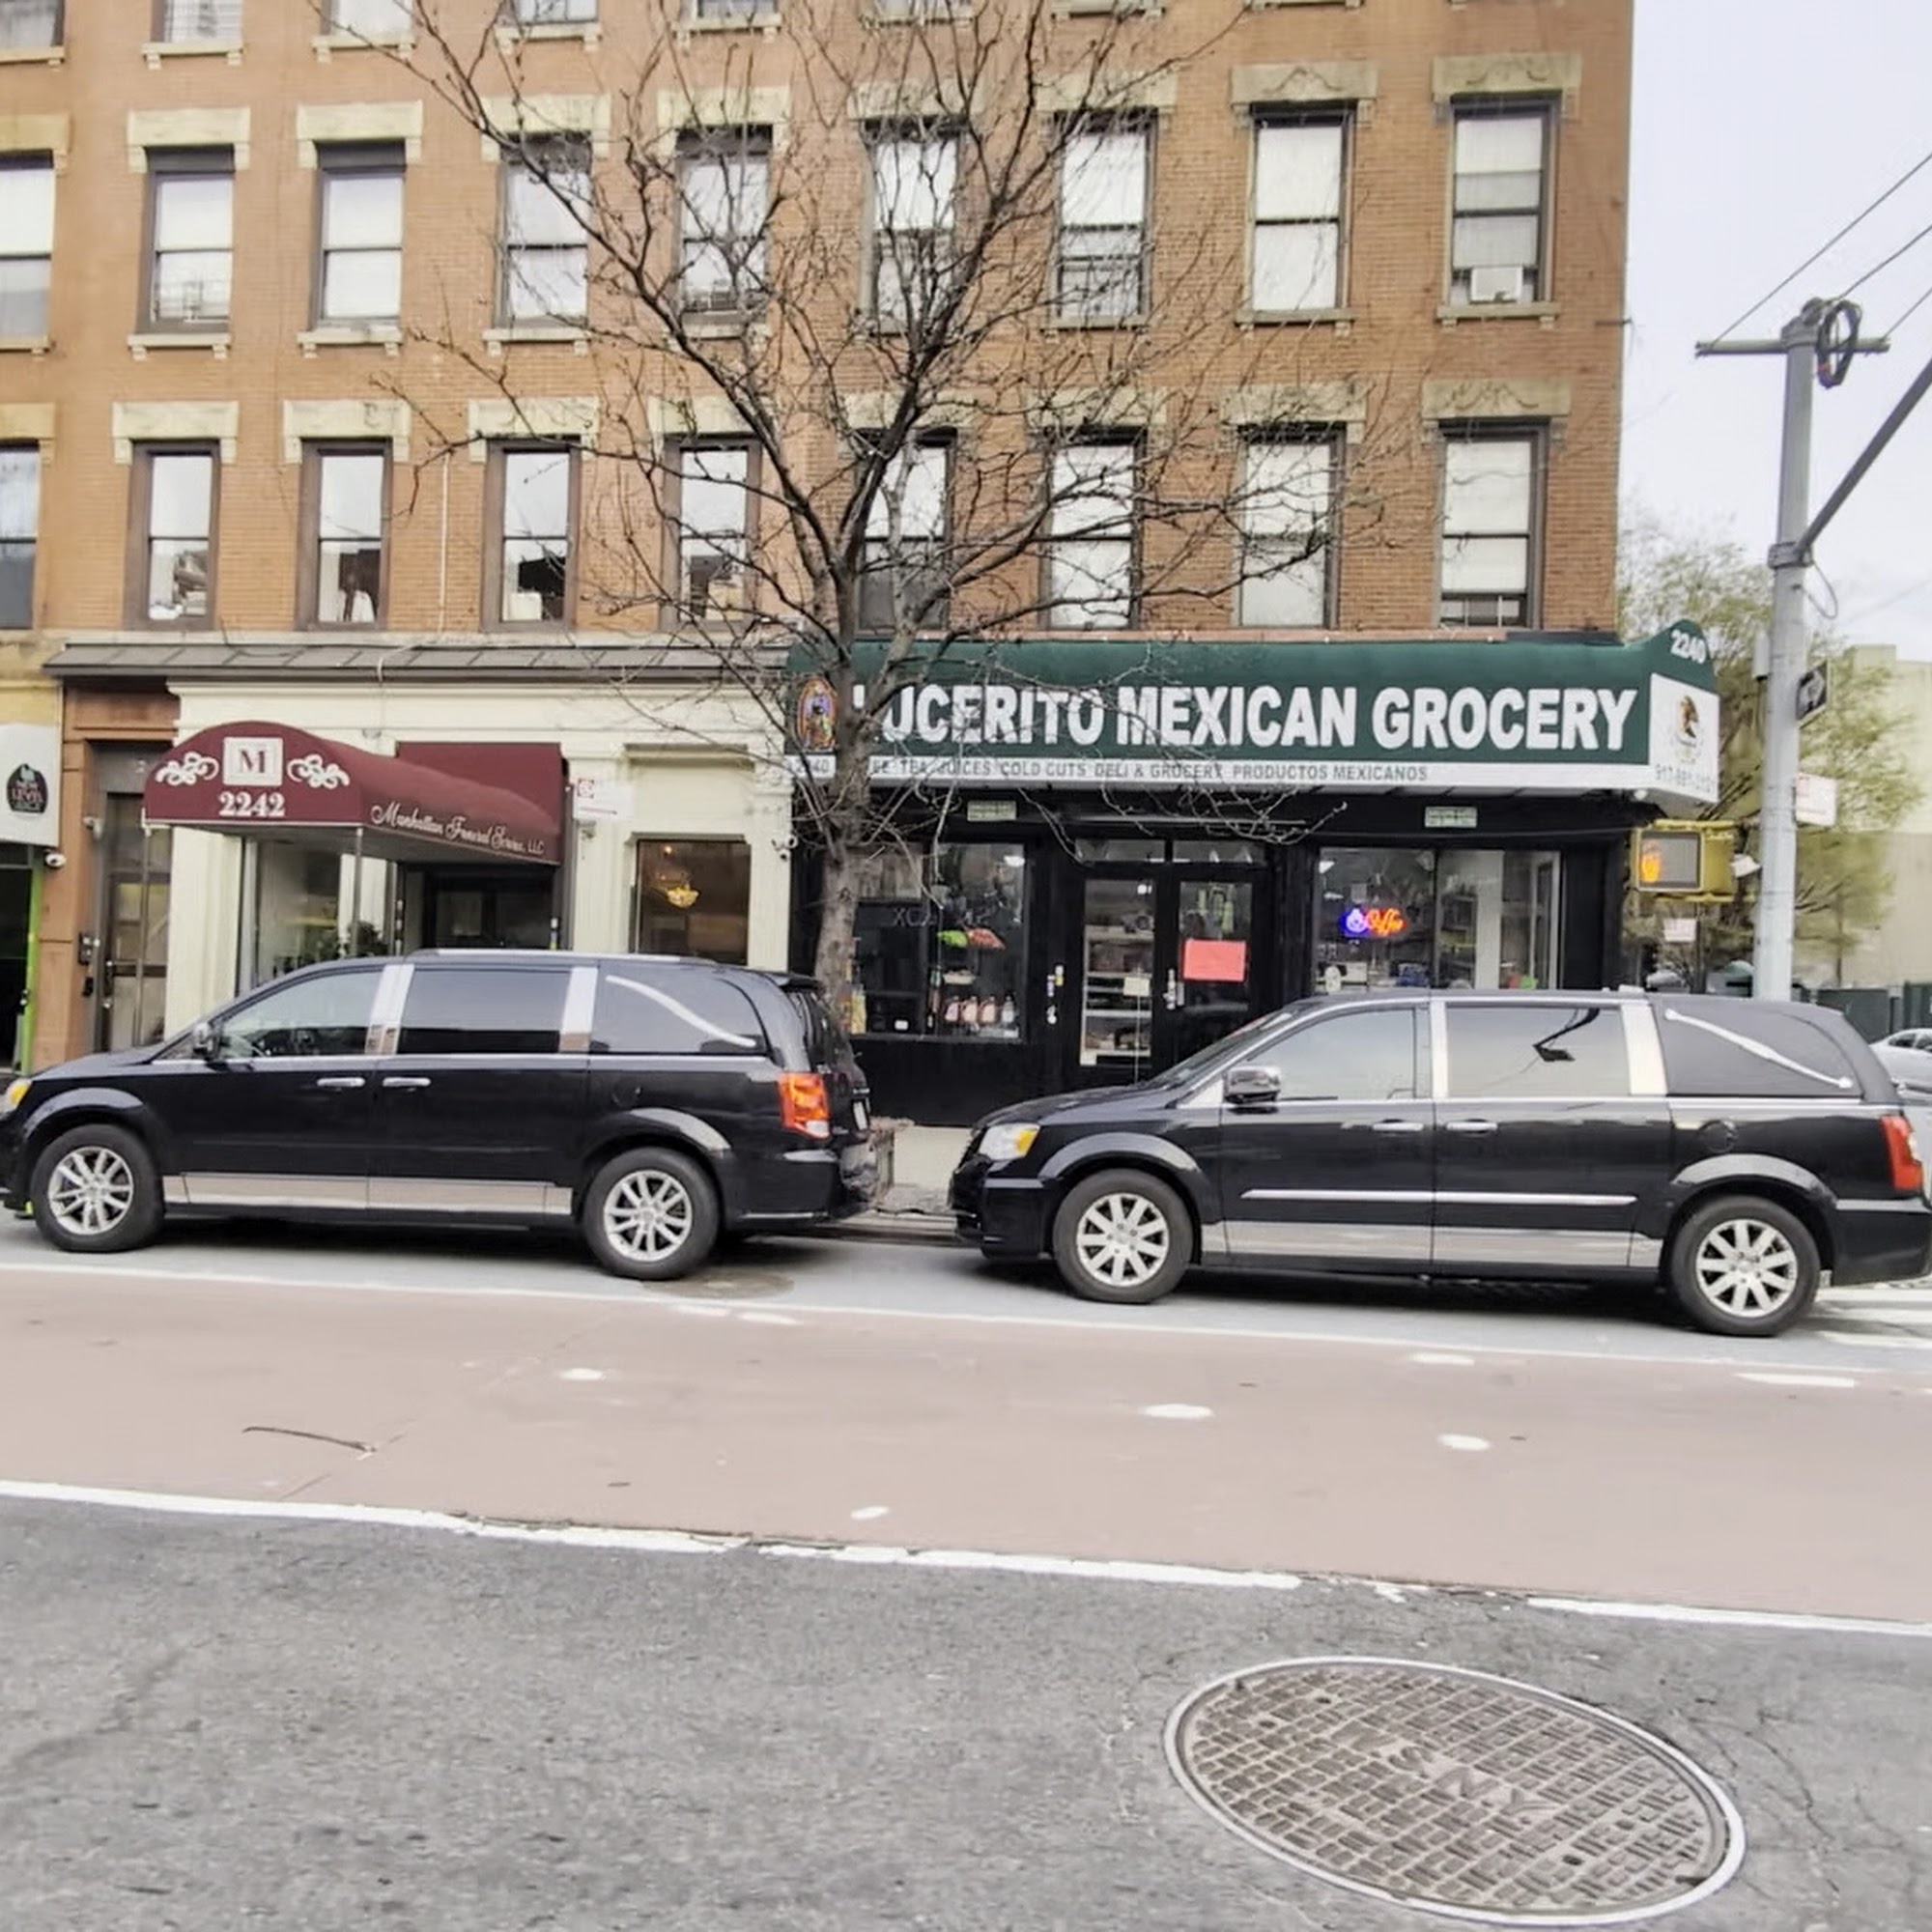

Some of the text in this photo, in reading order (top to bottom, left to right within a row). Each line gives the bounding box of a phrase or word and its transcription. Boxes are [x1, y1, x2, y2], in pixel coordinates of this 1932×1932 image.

[1670, 628, 1707, 665] 2240
[1117, 684, 1357, 748] MEXICAN
[1371, 686, 1638, 751] GROCERY
[239, 749, 267, 775] M
[1000, 757, 1041, 777] COLD
[1046, 758, 1088, 778] CUTS
[1094, 759, 1129, 779] DELI
[1150, 760, 1224, 780] GROCERY
[1232, 763, 1329, 781] PRODUCTOS
[1332, 764, 1429, 781] MEXICANOS
[217, 790, 287, 818] 2242
[370, 801, 444, 837] Manhattan
[444, 814, 493, 845] Funeral
[527, 839, 546, 855] LLC
